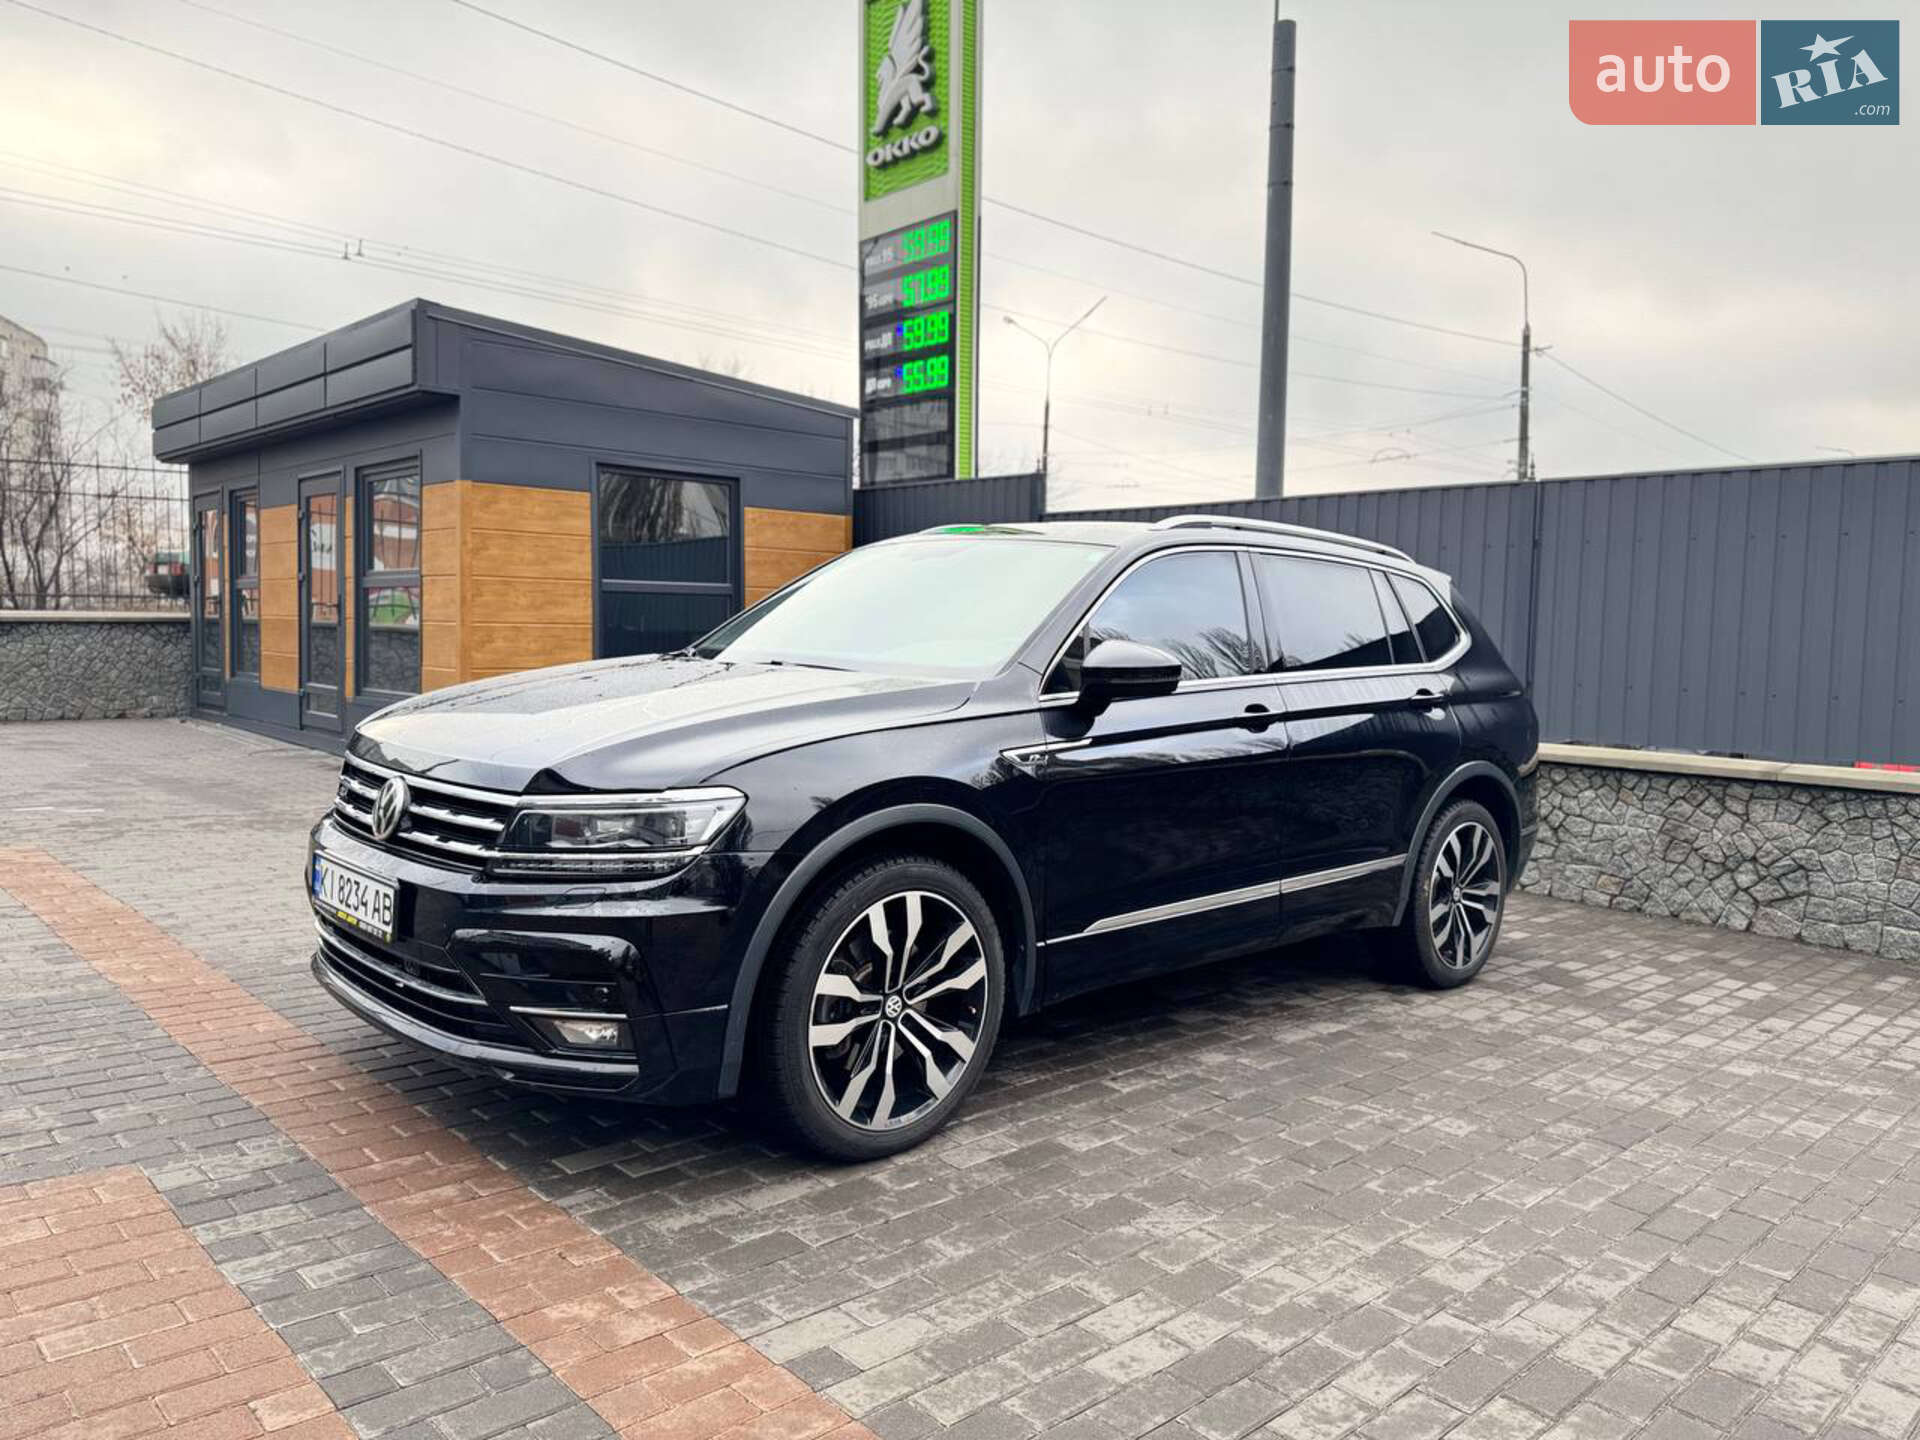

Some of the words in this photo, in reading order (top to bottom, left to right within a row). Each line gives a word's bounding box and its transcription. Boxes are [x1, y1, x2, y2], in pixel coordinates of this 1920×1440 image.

[866, 125, 938, 167] OKKO
[338, 874, 368, 917] 8234
[372, 889, 392, 926] AB
